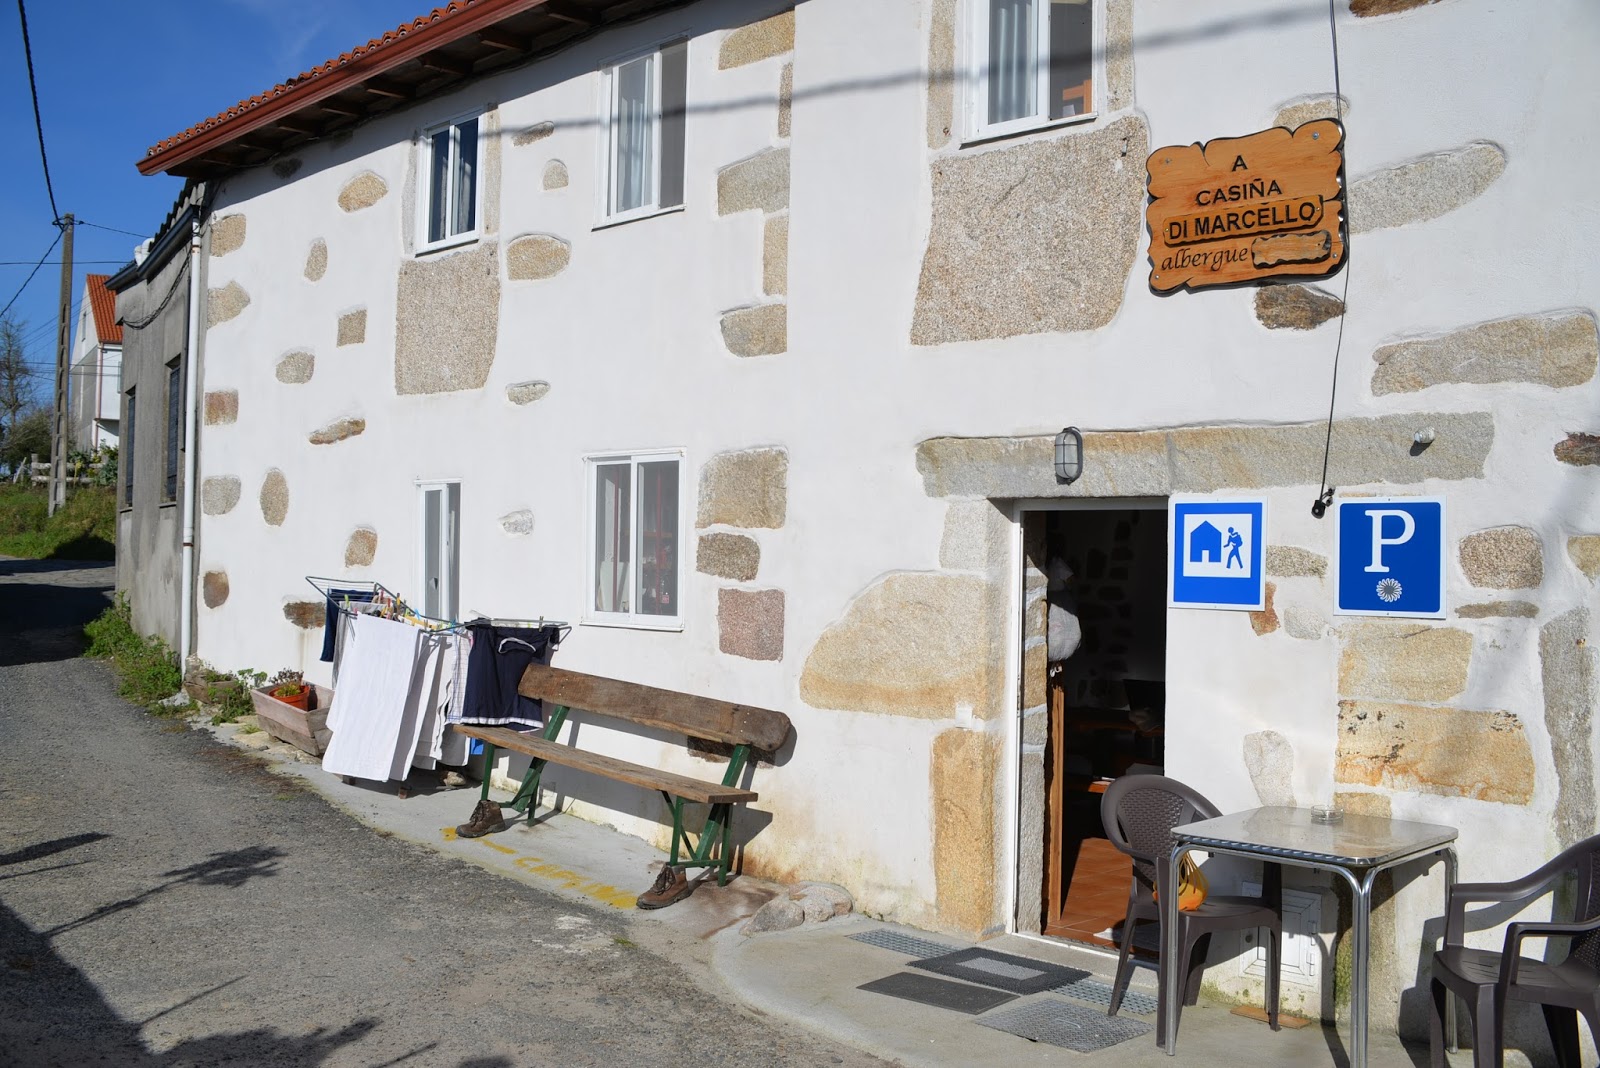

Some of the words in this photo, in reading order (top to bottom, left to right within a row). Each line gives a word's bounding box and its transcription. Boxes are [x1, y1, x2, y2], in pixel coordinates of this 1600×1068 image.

[1231, 155, 1248, 172] A
[1197, 178, 1283, 206] CASIÑA
[1169, 221, 1188, 240] DI
[1194, 202, 1316, 236] MARCELLO
[1161, 247, 1248, 272] albergue
[1364, 509, 1415, 573] P
